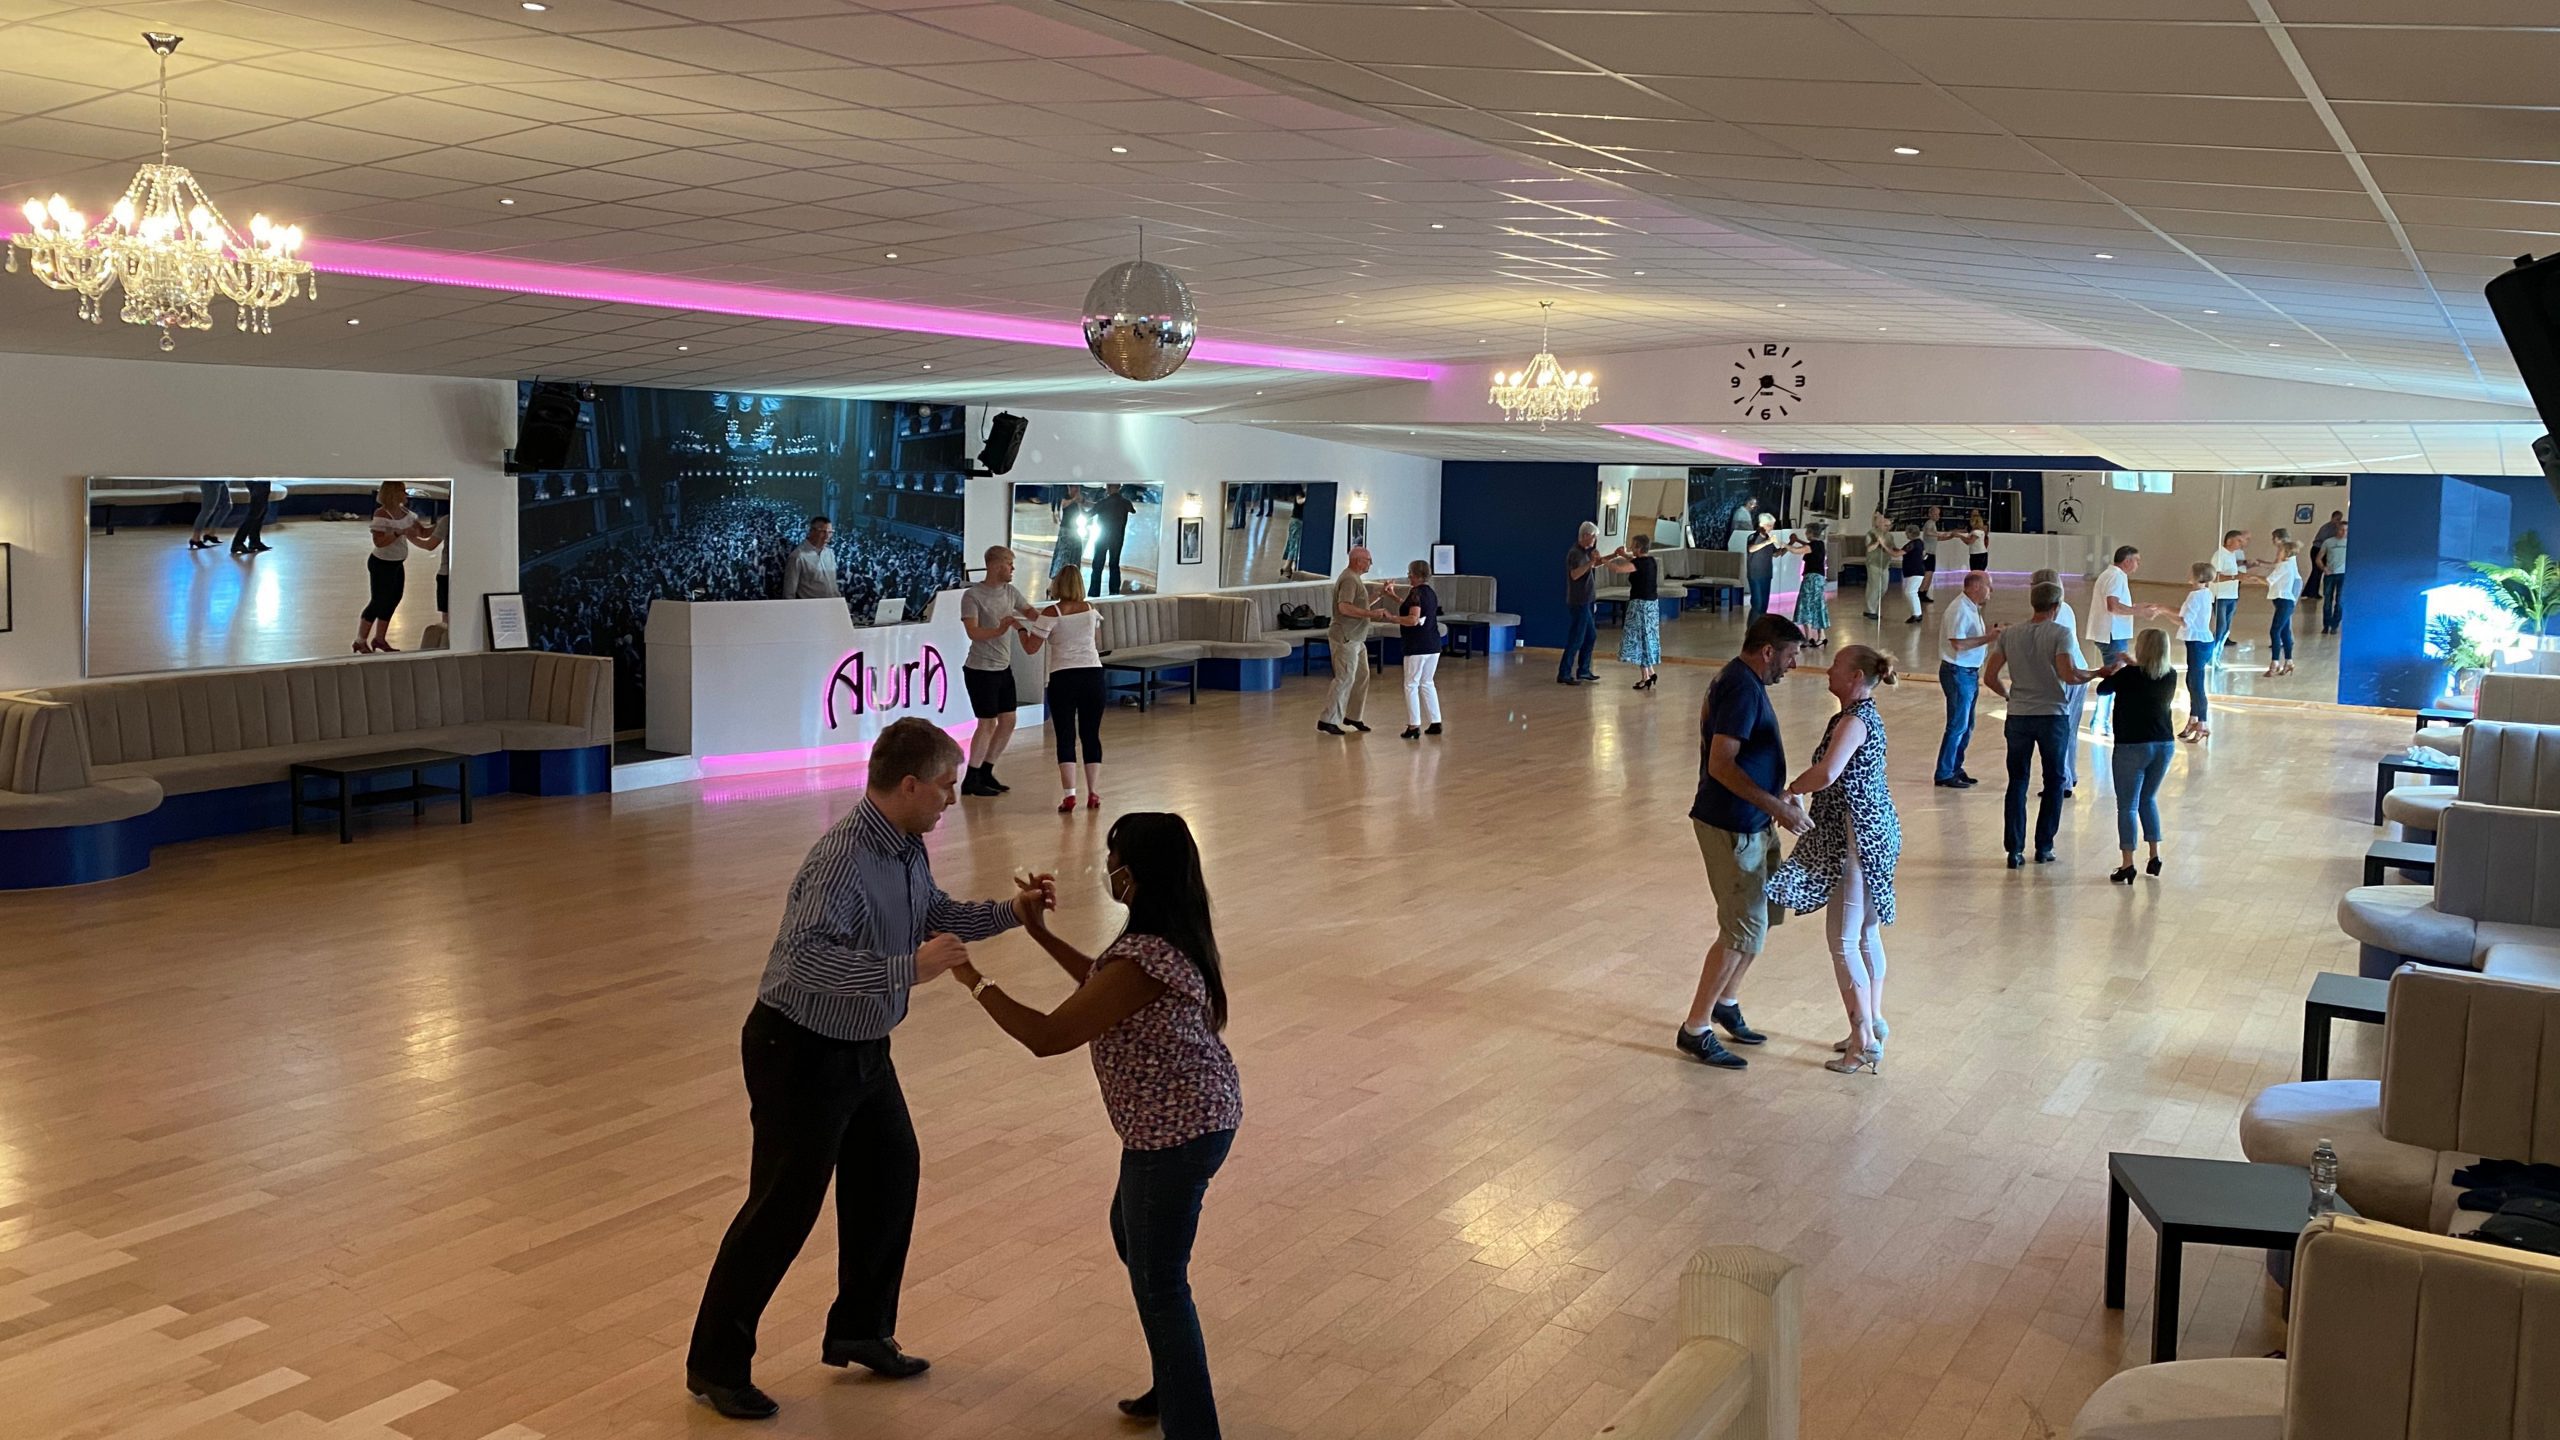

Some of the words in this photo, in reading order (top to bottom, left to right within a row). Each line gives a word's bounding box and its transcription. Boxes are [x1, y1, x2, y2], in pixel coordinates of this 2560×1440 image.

[1763, 344, 1777, 356] 12
[1731, 376, 1740, 388] 9
[1795, 375, 1805, 387] 3
[1761, 409, 1770, 420] 6
